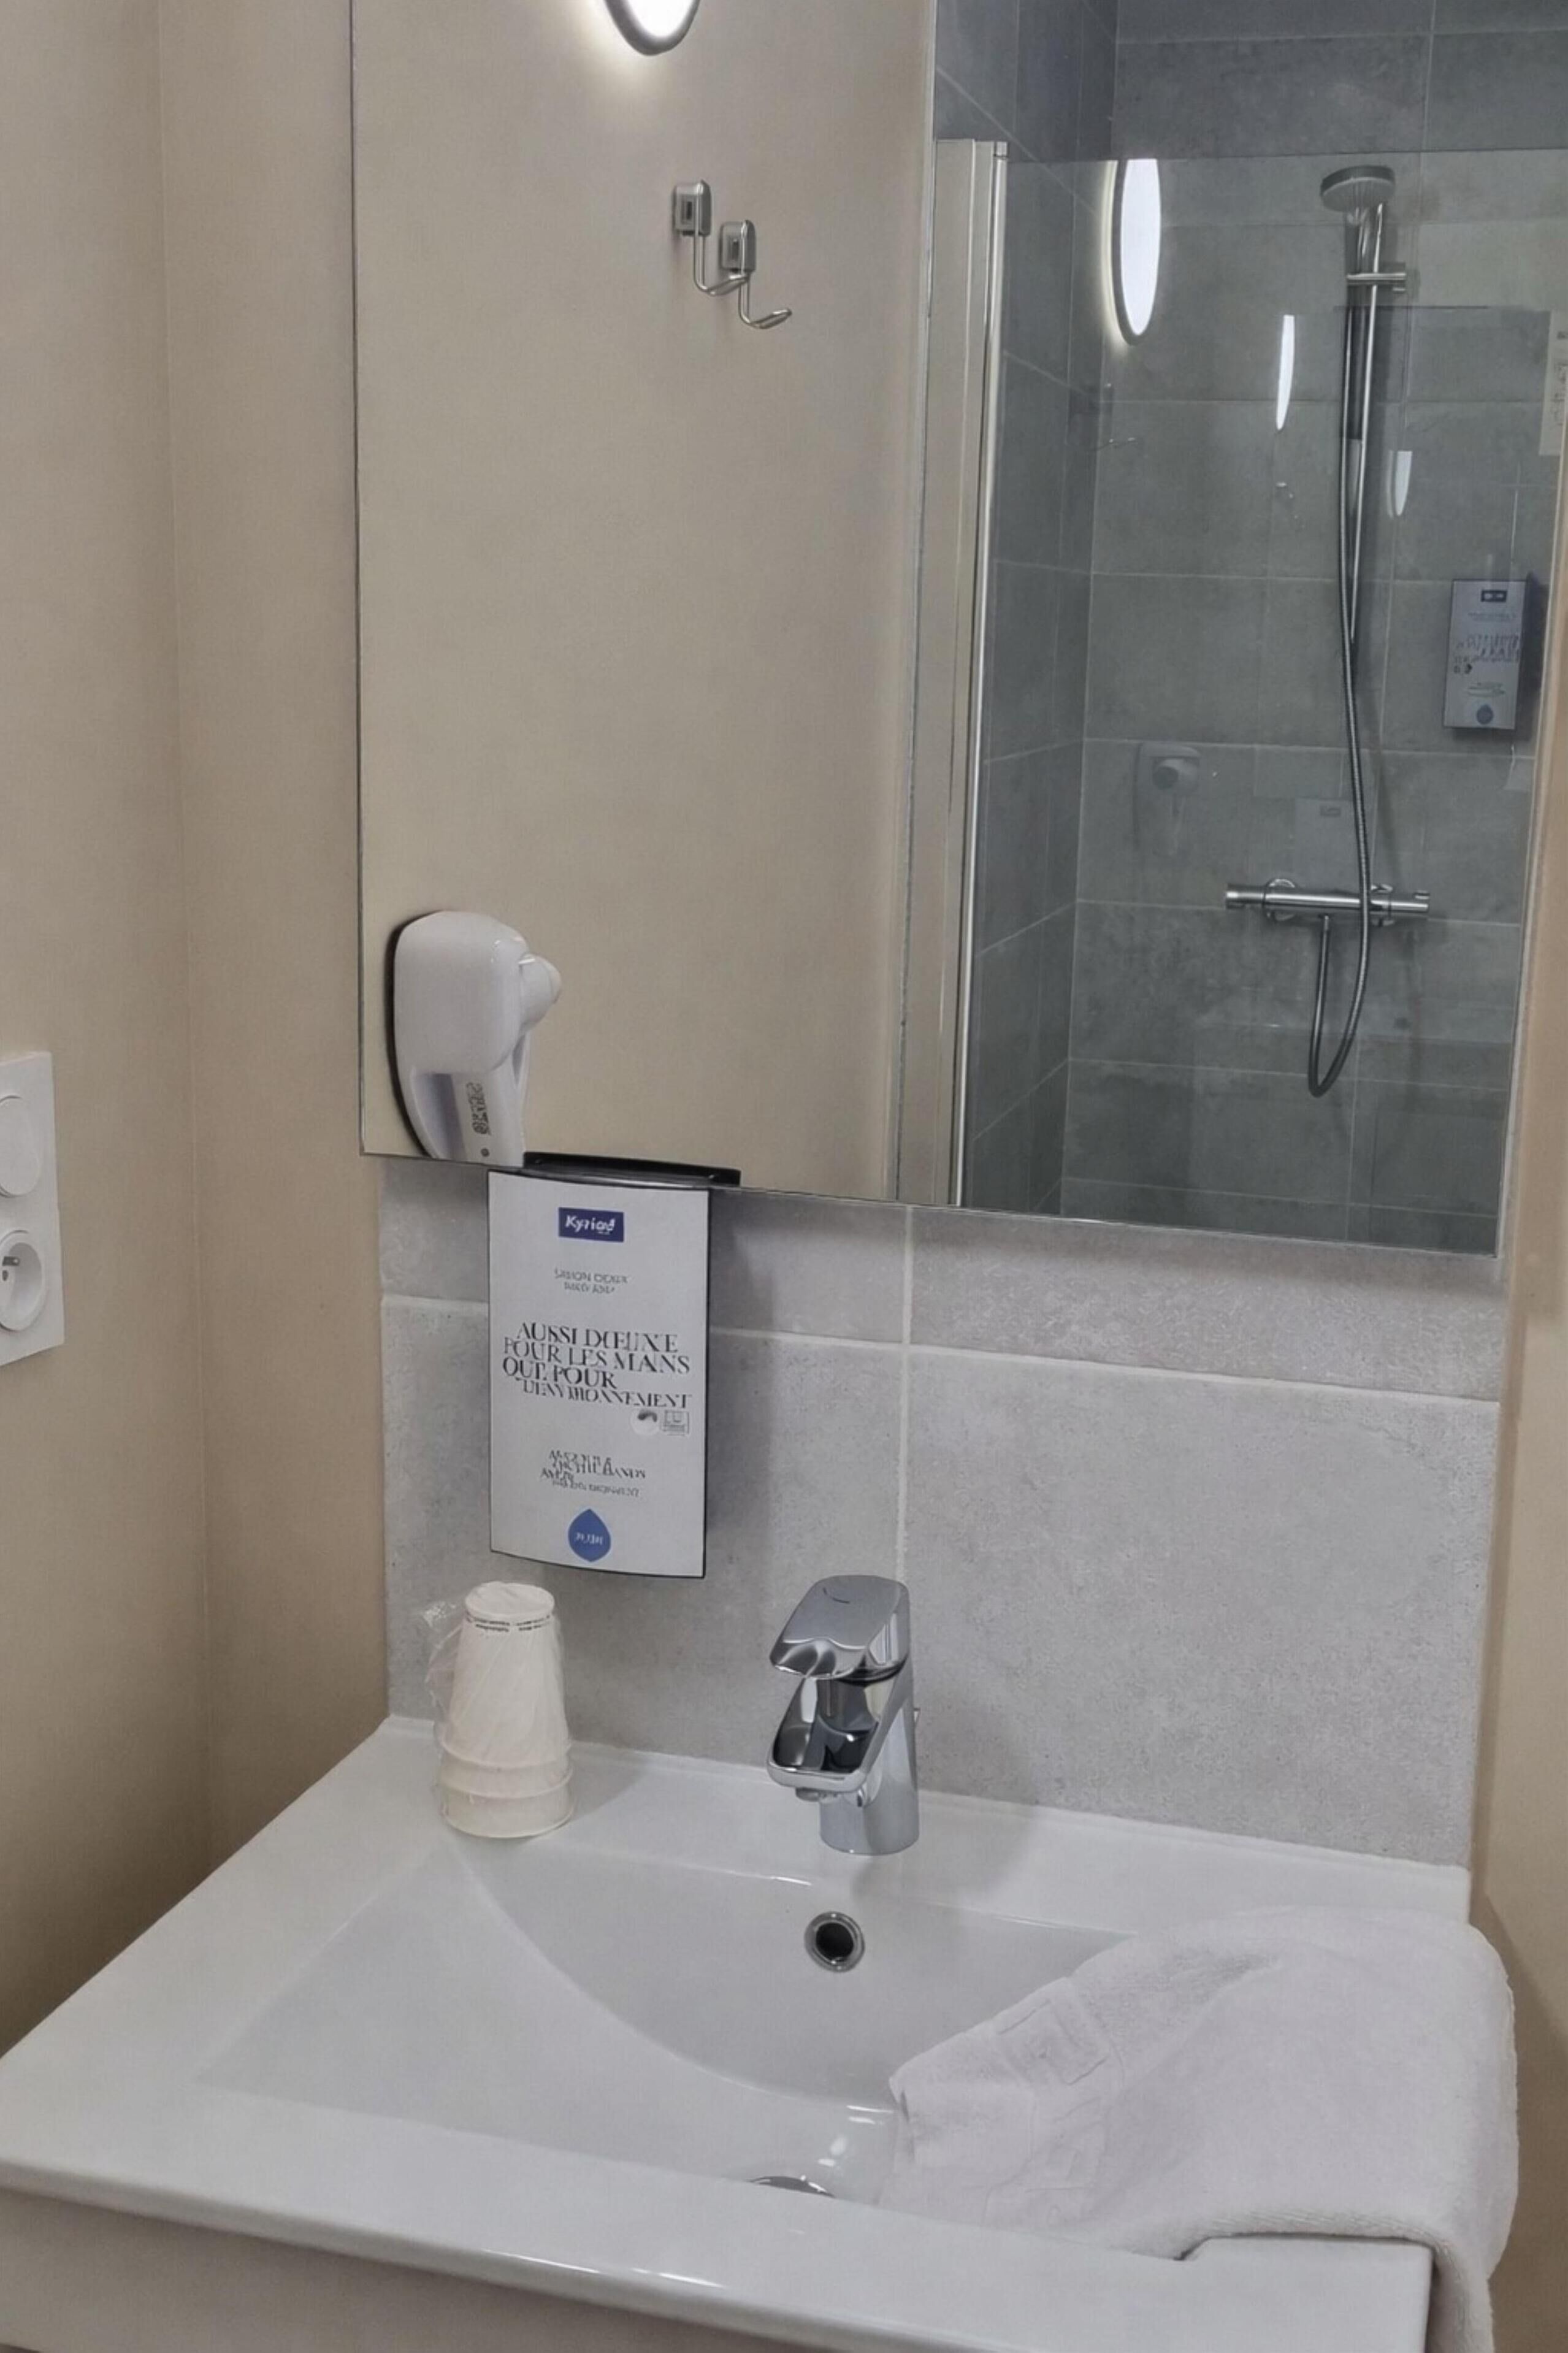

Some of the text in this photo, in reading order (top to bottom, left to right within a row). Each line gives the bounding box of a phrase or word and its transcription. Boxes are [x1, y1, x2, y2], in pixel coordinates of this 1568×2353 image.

[504, 1336, 562, 1364] POUR
[568, 1347, 608, 1367] LES
[553, 1364, 618, 1390] POUR
